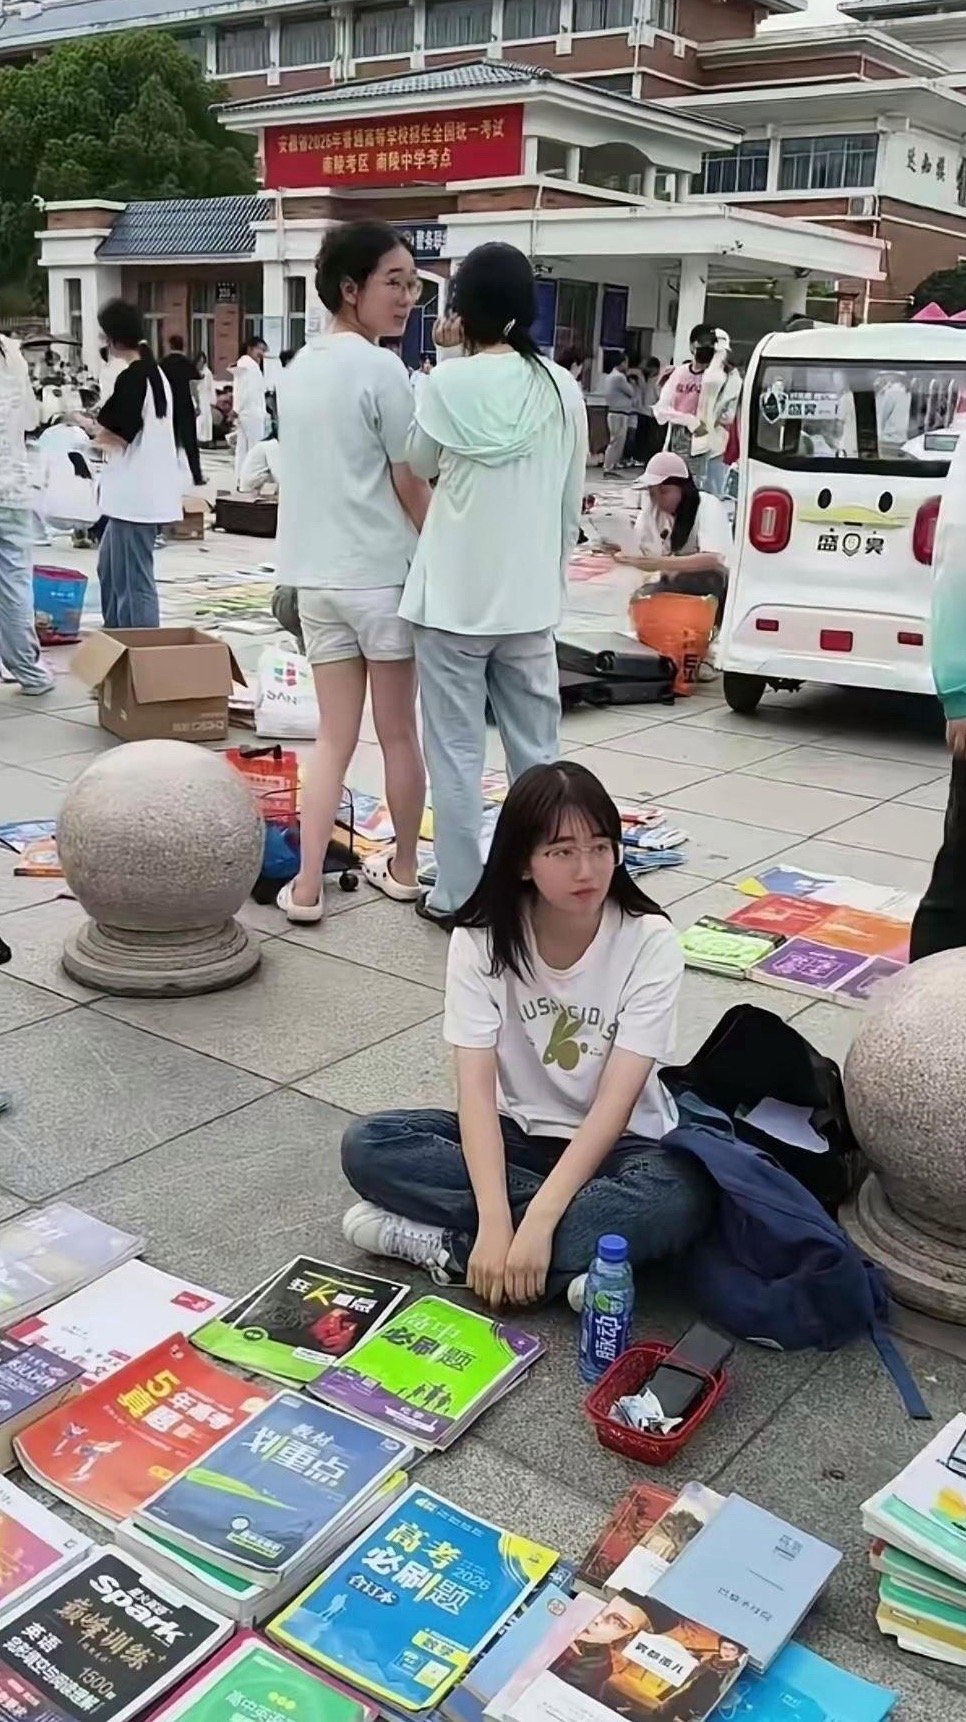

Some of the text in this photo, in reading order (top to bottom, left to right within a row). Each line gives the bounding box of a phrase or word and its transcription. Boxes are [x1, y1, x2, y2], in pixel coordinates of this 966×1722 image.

[322, 148, 452, 176] 南陵考区 南陵中学考点
[380, 1325, 477, 1373] 必刷题
[595, 1315, 623, 1362] 脉动
[241, 1425, 350, 1488] 划重点
[384, 1520, 463, 1571] 高考
[348, 1573, 399, 1606] 合订本
[361, 1546, 476, 1617] 必刷题
[452, 1566, 491, 1592] 2026
[53, 1597, 151, 1671] 巅峰训练
[89, 1574, 186, 1646] Spark
[20, 1621, 64, 1653] 英语
